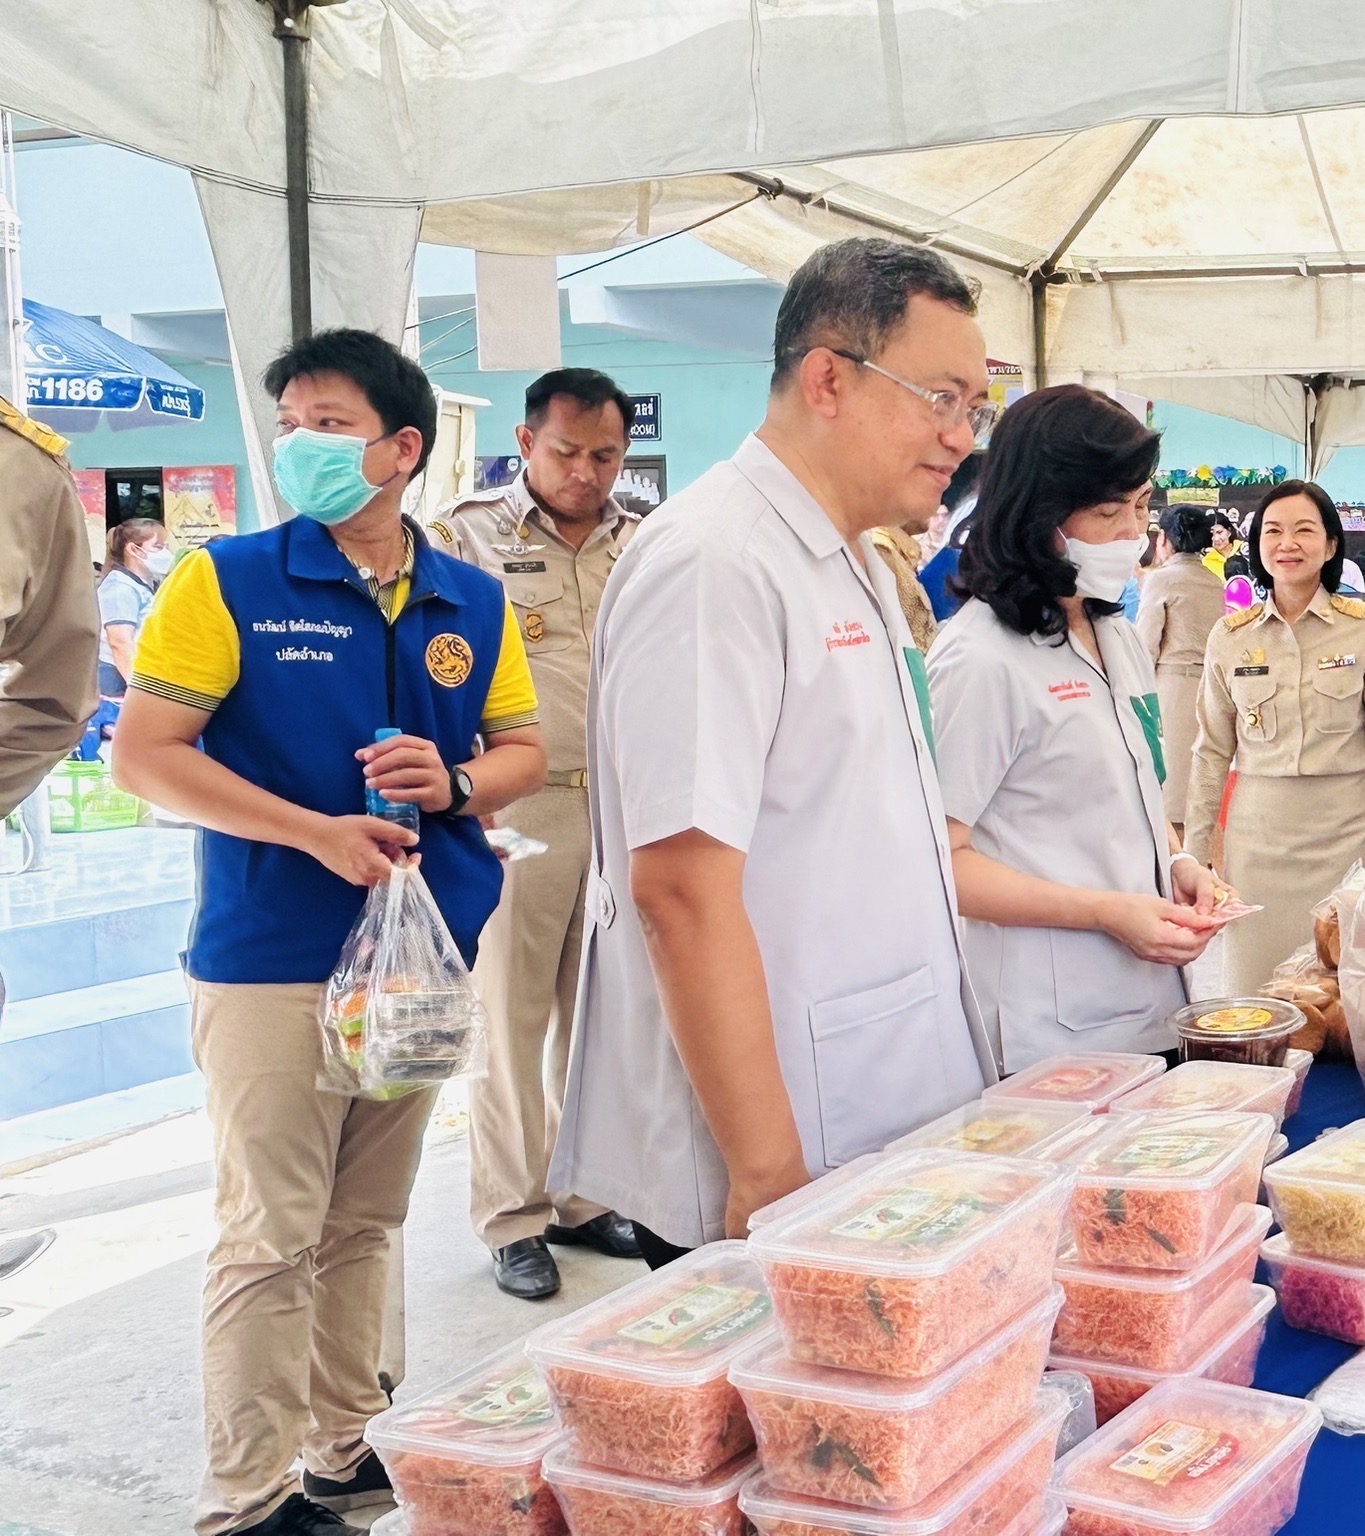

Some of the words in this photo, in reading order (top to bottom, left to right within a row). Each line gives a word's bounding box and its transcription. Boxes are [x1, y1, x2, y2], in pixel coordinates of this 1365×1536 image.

[42, 377, 104, 402] 1186
[275, 646, 334, 662] ปลัดอำเภอ
